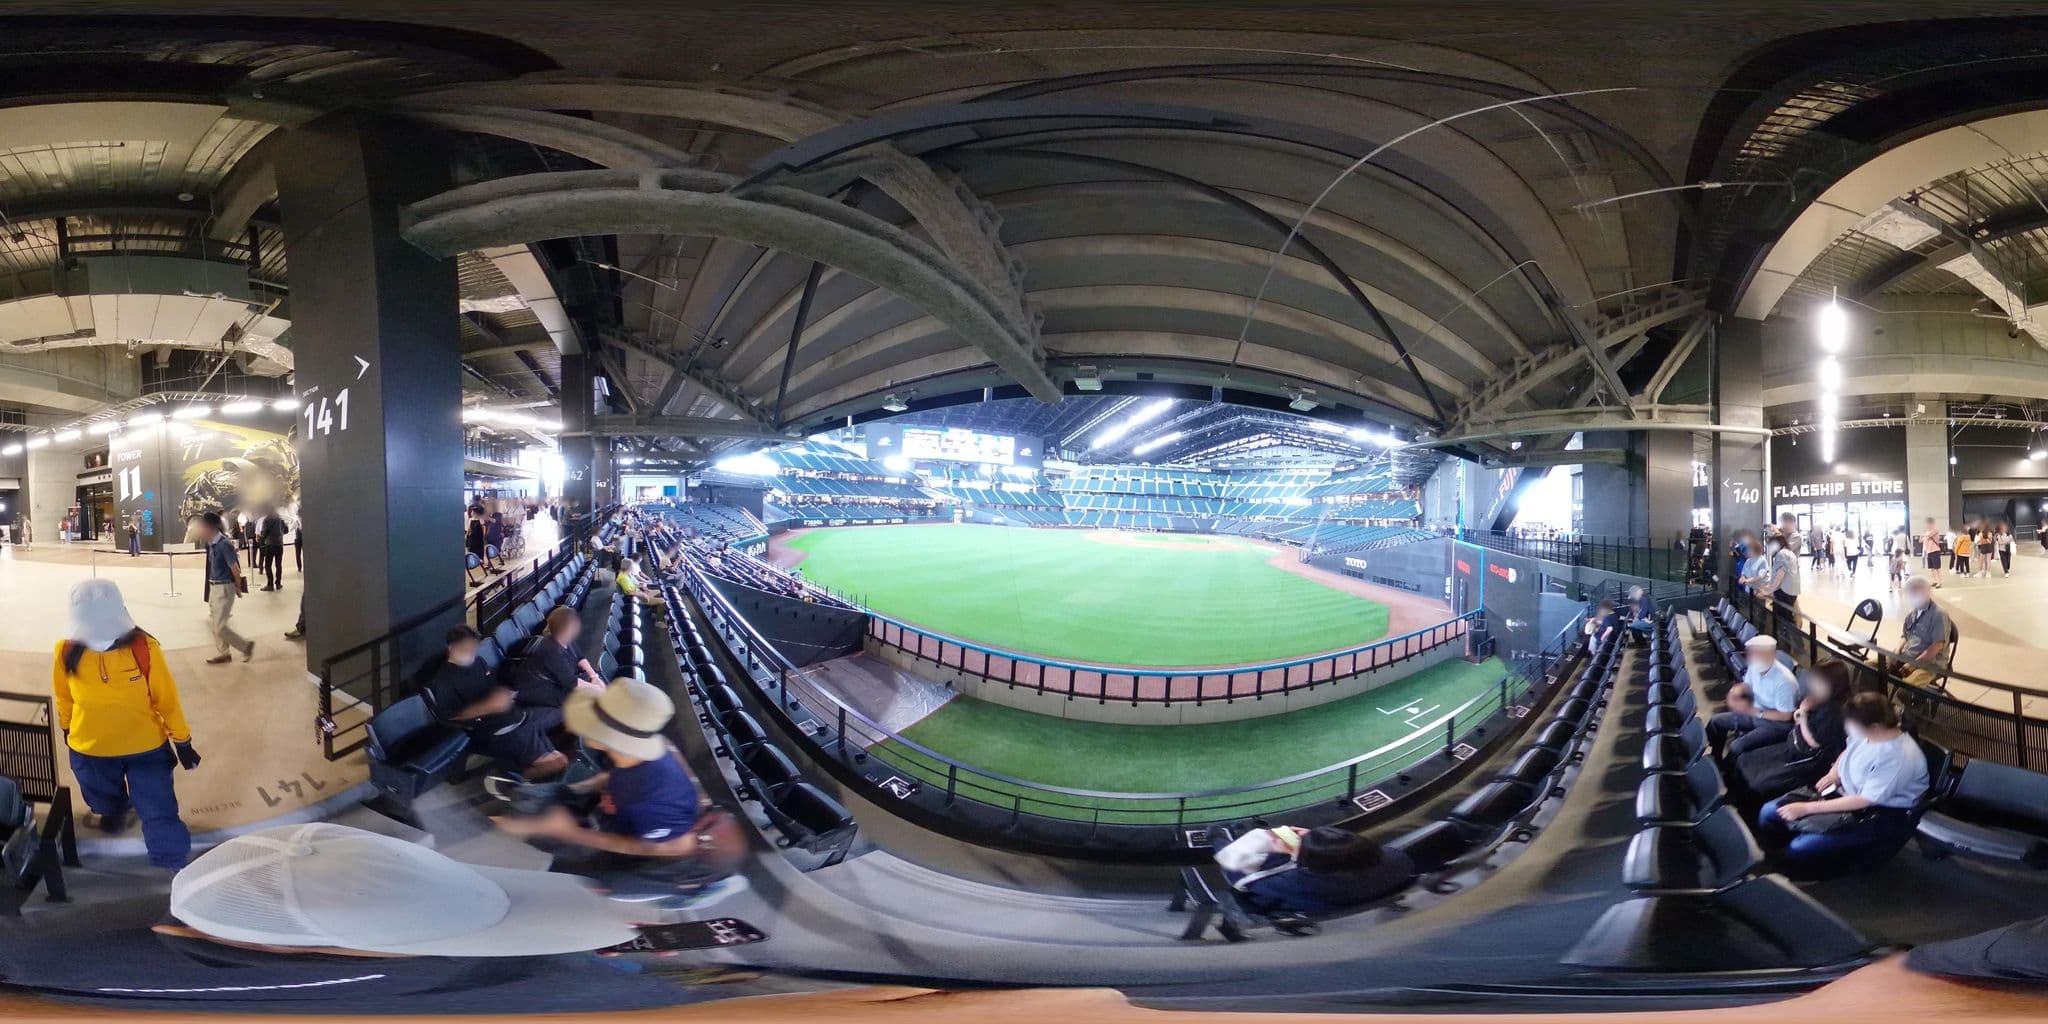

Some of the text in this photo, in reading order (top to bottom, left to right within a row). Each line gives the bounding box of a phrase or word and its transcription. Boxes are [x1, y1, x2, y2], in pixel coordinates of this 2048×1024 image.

[304, 388, 349, 440] 141
[117, 449, 142, 462] TOWER
[118, 465, 142, 502] 11
[1773, 480, 1904, 498] FLAGSHIP STORE
[1733, 488, 1759, 504] 140
[1345, 557, 1367, 569] TOTO
[256, 772, 328, 808] 141
